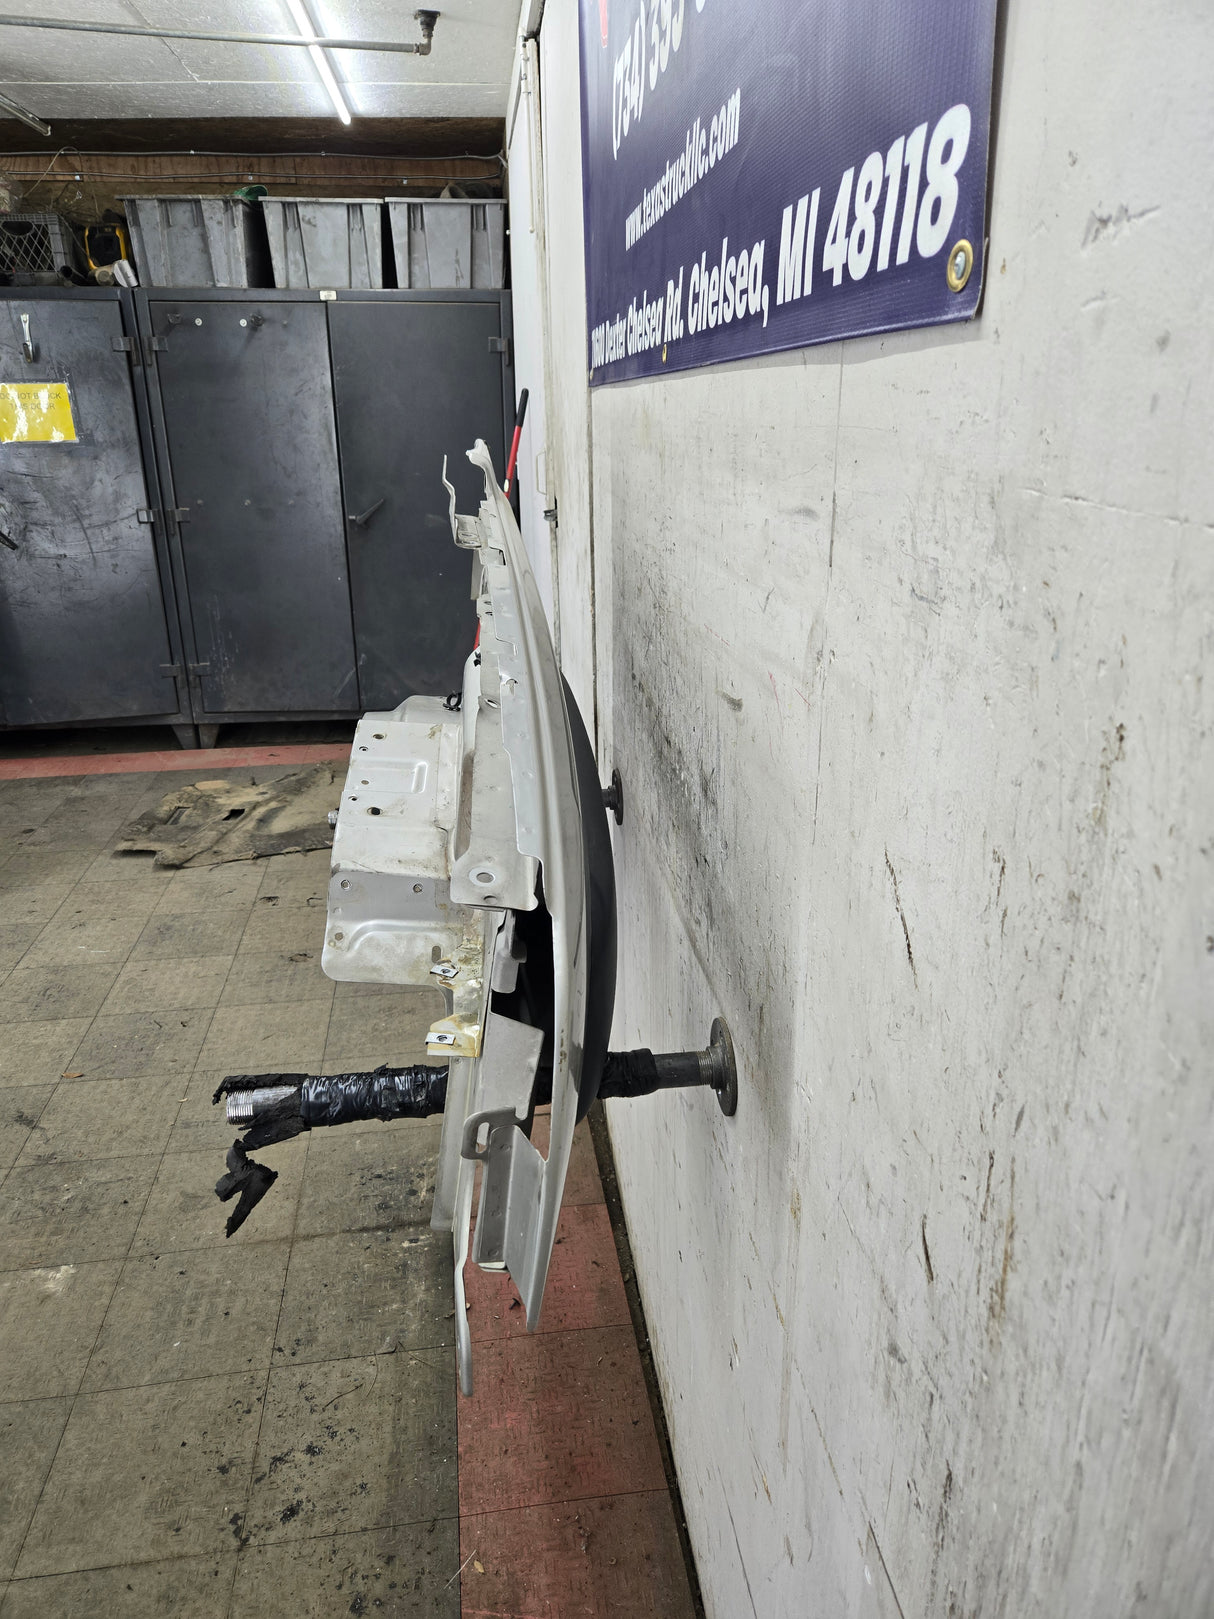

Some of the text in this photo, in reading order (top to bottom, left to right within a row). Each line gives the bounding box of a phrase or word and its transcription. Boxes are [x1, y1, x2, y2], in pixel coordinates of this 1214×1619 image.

[612, 0, 646, 161] (734)
[605, 313, 627, 364] Dexter
[627, 290, 664, 356] Chelsea
[664, 266, 684, 343] Rd.
[688, 236, 769, 335] Chelsea,
[776, 187, 821, 306] MI
[822, 103, 971, 287] 48118
